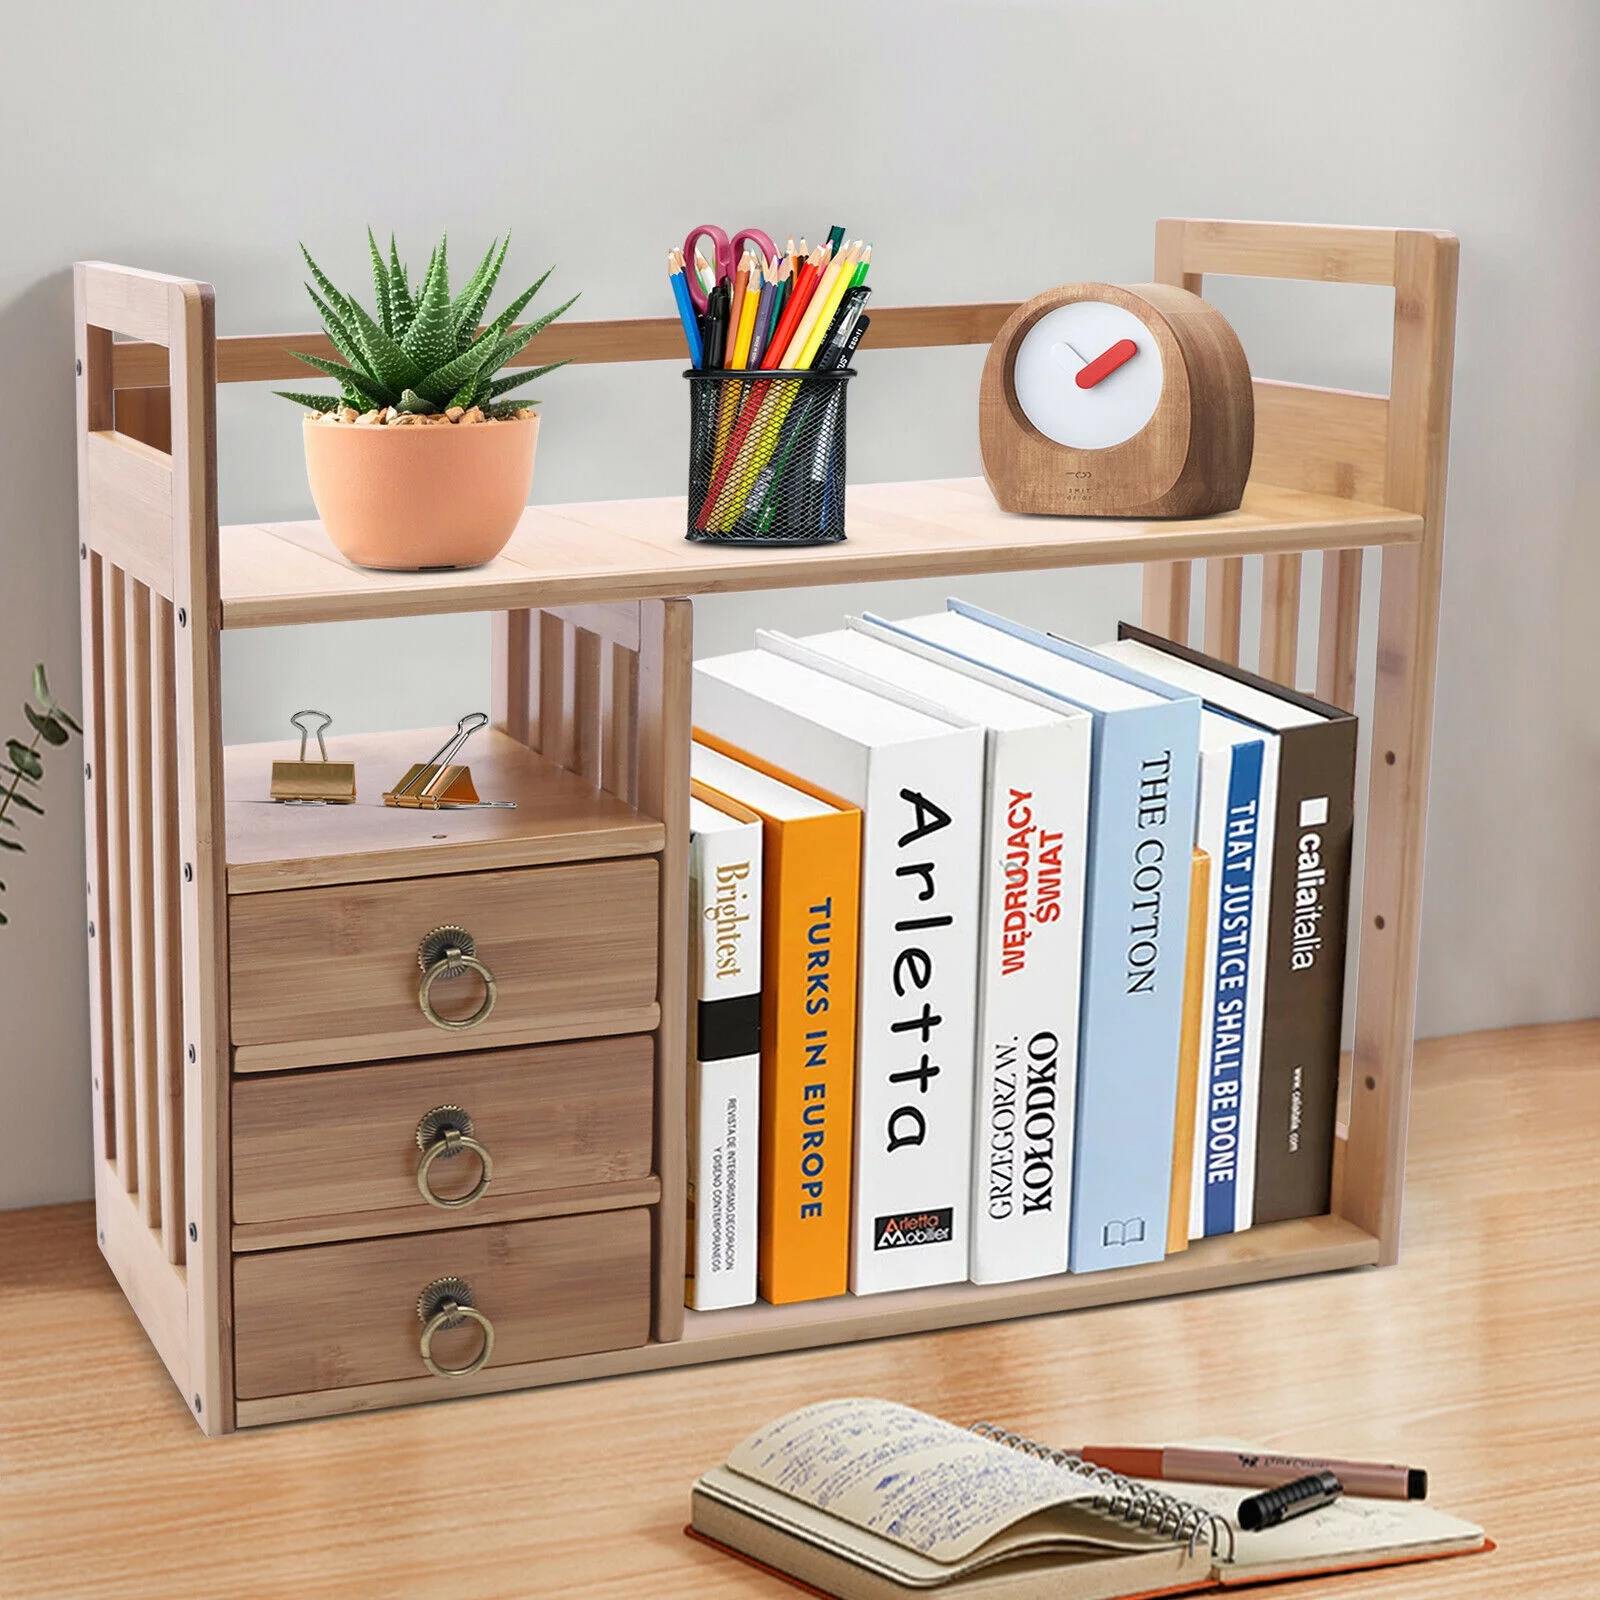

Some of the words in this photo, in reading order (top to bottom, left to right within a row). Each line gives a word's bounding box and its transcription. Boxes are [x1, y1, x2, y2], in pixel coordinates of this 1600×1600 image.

[1139, 749, 1171, 829] THE
[1225, 800, 1256, 872] THAT
[704, 861, 750, 980] Brightest
[1001, 788, 1037, 976] WĘDRUJĄCY
[1029, 829, 1063, 924] ŚWIAT
[1127, 838, 1164, 994] COTTON
[1291, 833, 1325, 970] caliaitalia
[806, 897, 832, 1015] TURKS
[886, 787, 953, 1153] Arletta
[1218, 883, 1248, 991] JUSTICE
[805, 1031, 828, 1067] IN
[994, 1036, 1019, 1070] W.
[1214, 1001, 1242, 1076] SHALL
[727, 1098, 737, 1135] REVISTA
[1023, 1031, 1059, 1216] KOŁODKO
[1211, 1080, 1239, 1110] BE
[727, 1137, 736, 1149] DE
[801, 1083, 826, 1220] EUROPE
[988, 1072, 1016, 1220] GRZEGORZ
[1208, 1114, 1237, 1185] DONE
[884, 1215, 940, 1233] Arletta
